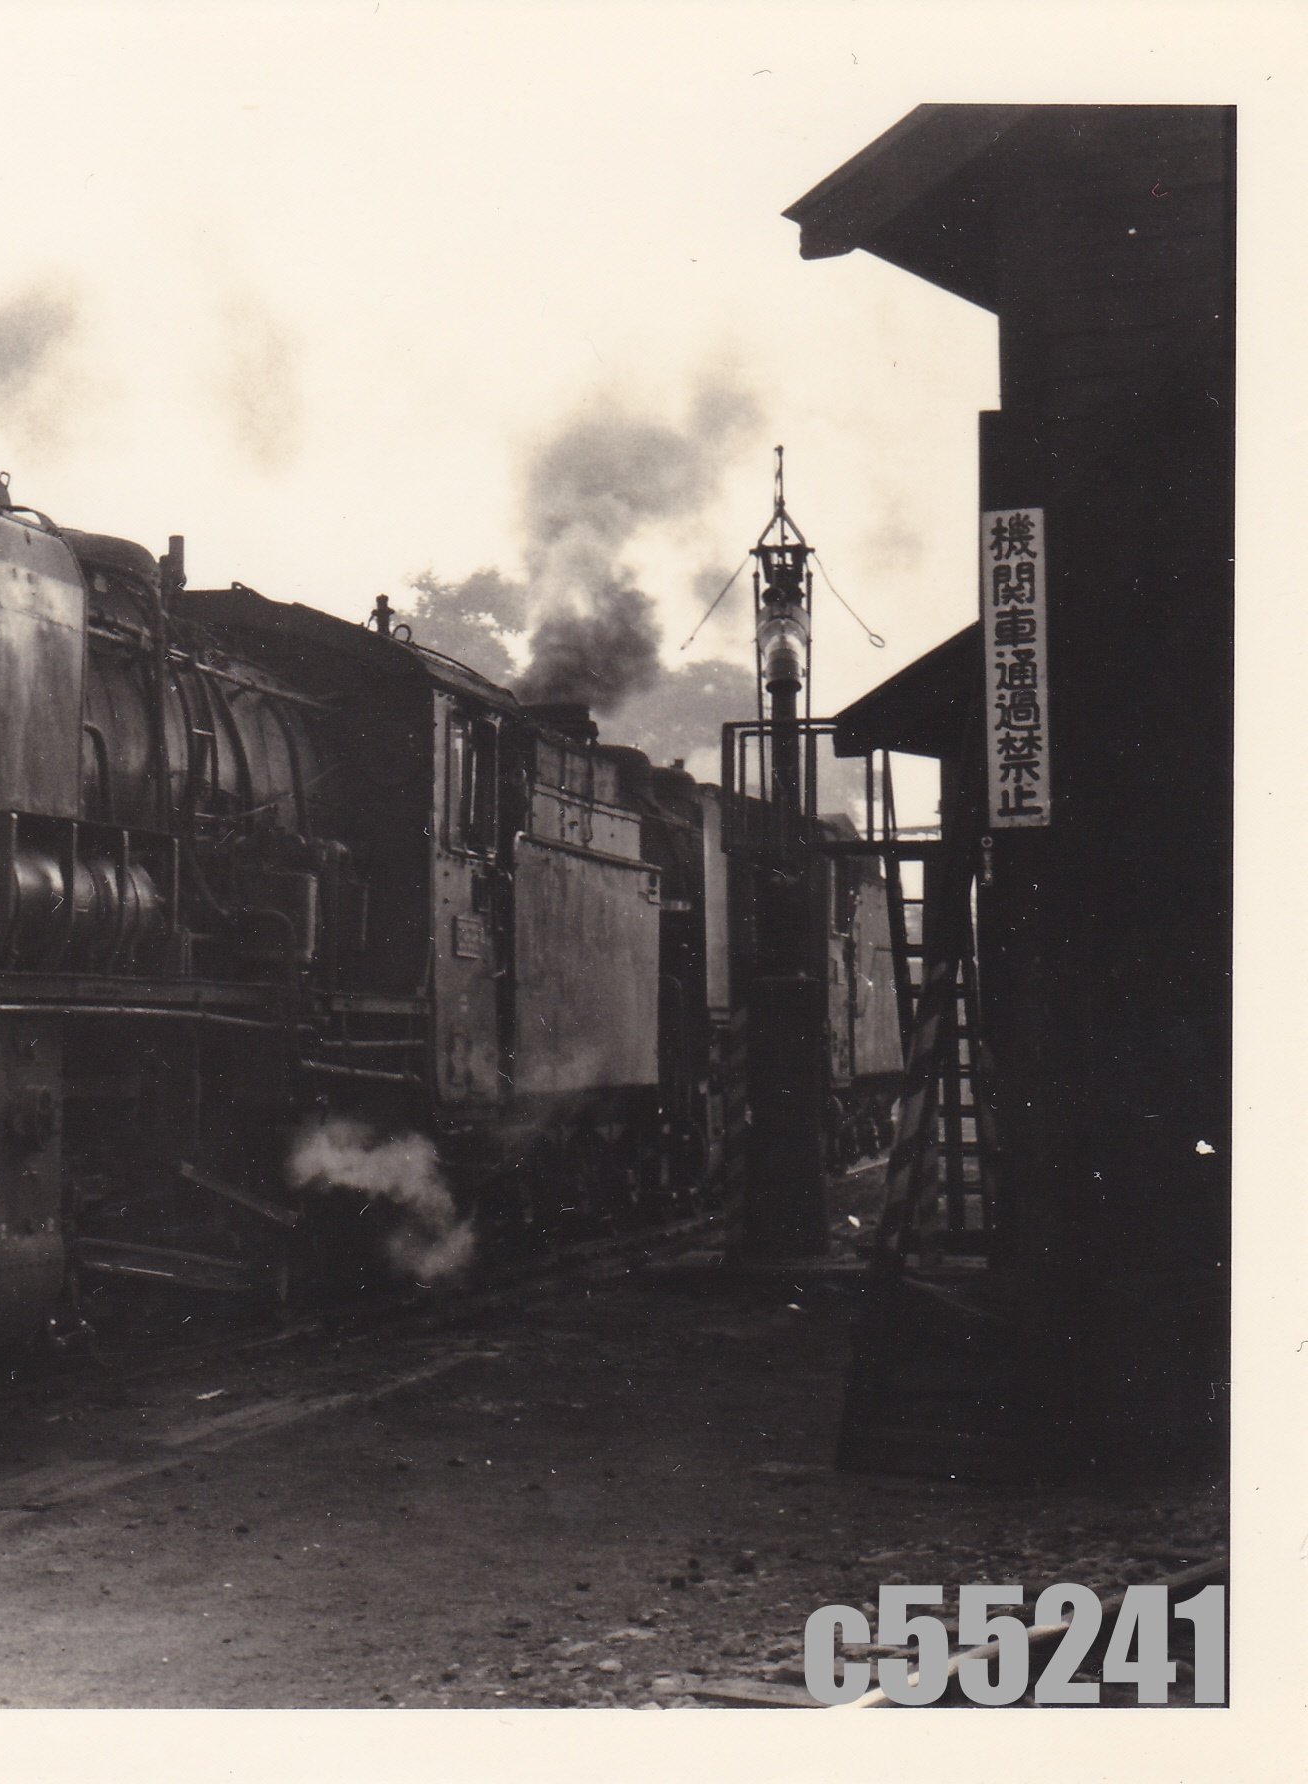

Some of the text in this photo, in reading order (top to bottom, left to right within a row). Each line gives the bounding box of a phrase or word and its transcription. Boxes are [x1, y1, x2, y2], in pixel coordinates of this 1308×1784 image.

[990, 512, 1042, 818] 機関車通過禁止
